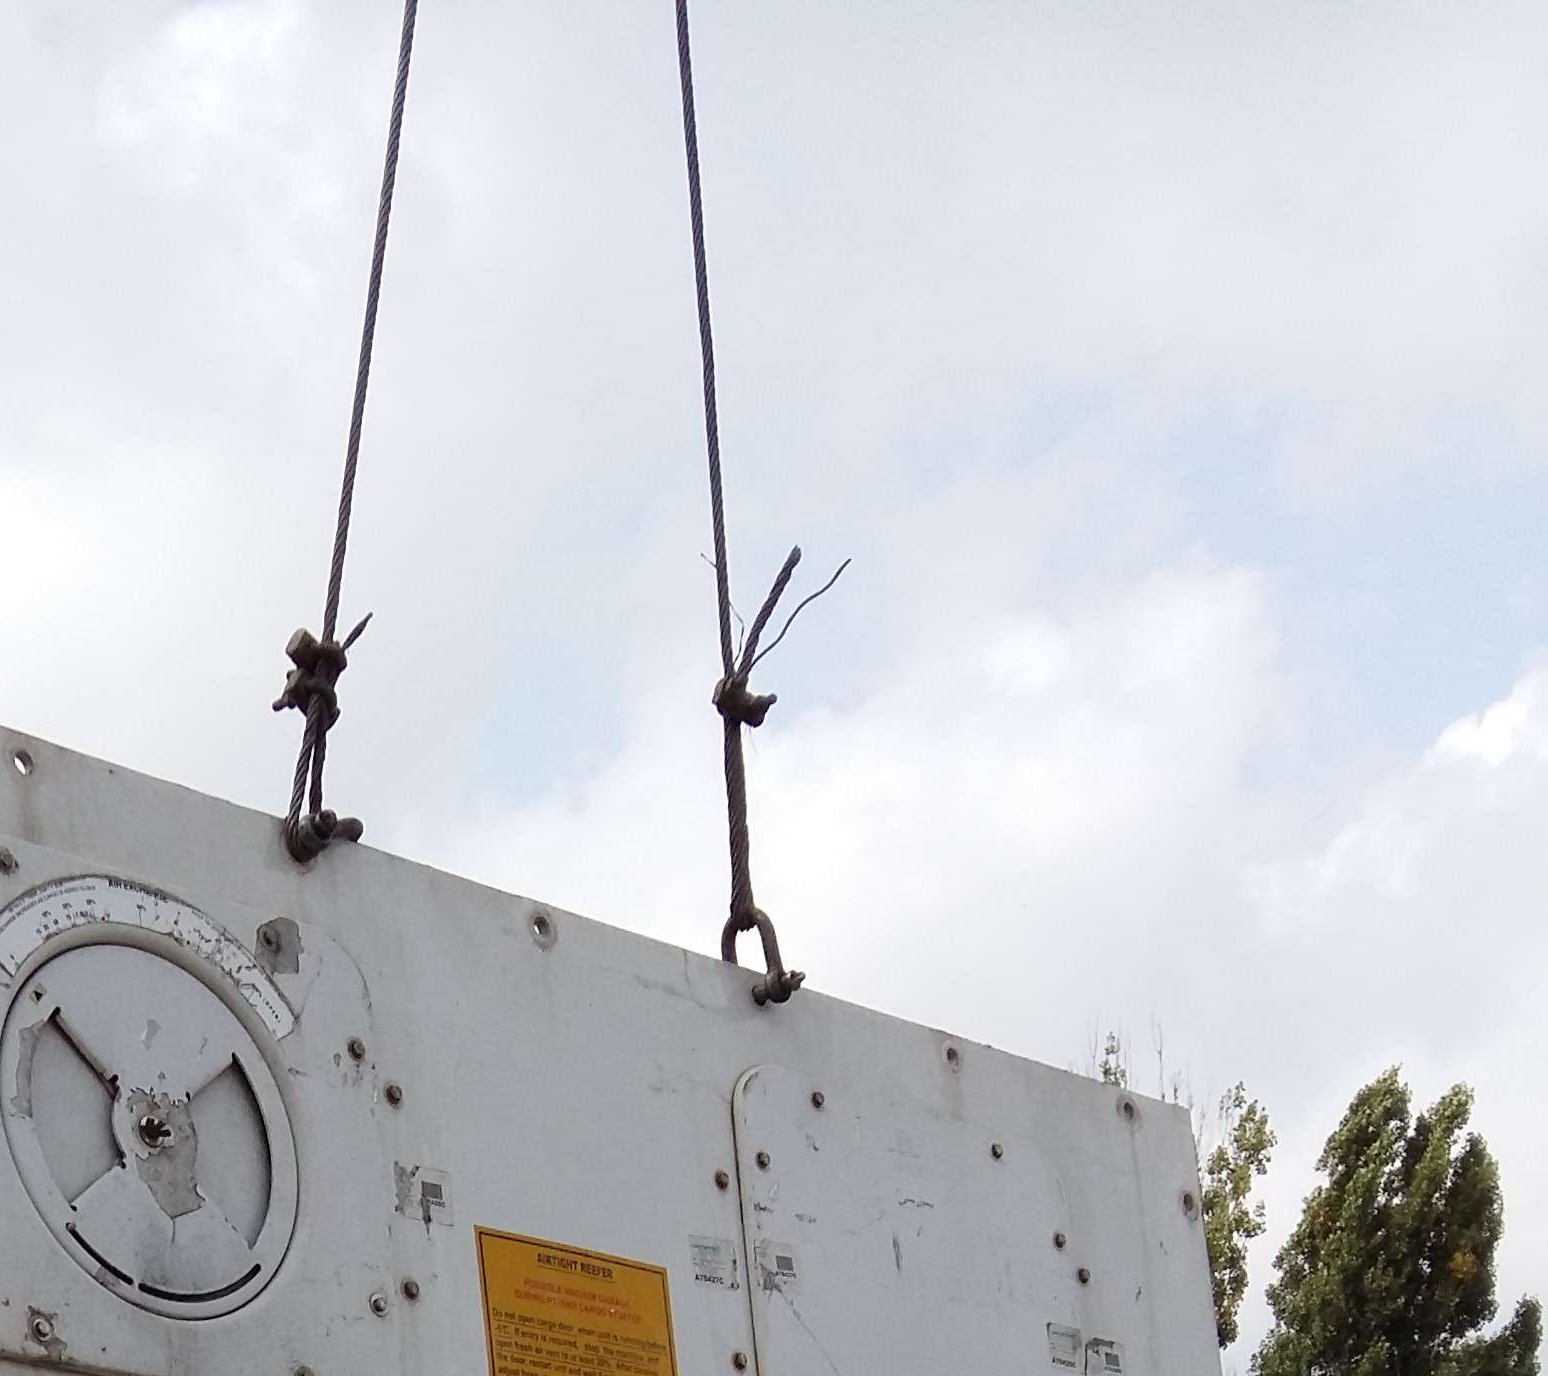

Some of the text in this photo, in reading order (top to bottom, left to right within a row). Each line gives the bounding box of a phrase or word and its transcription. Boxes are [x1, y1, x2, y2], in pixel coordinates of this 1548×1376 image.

[537, 1252, 614, 1280] AIRTIGHT REEFER
[492, 1306, 503, 1317] Do
[504, 1309, 516, 1319] not
[518, 1313, 535, 1325] open
[536, 1317, 557, 1331] cargo
[521, 1329, 540, 1342] entry
[514, 1341, 534, 1352] fresh
[535, 1346, 544, 1354] air
[545, 1347, 561, 1358] vent
[568, 1365, 582, 1375] and
